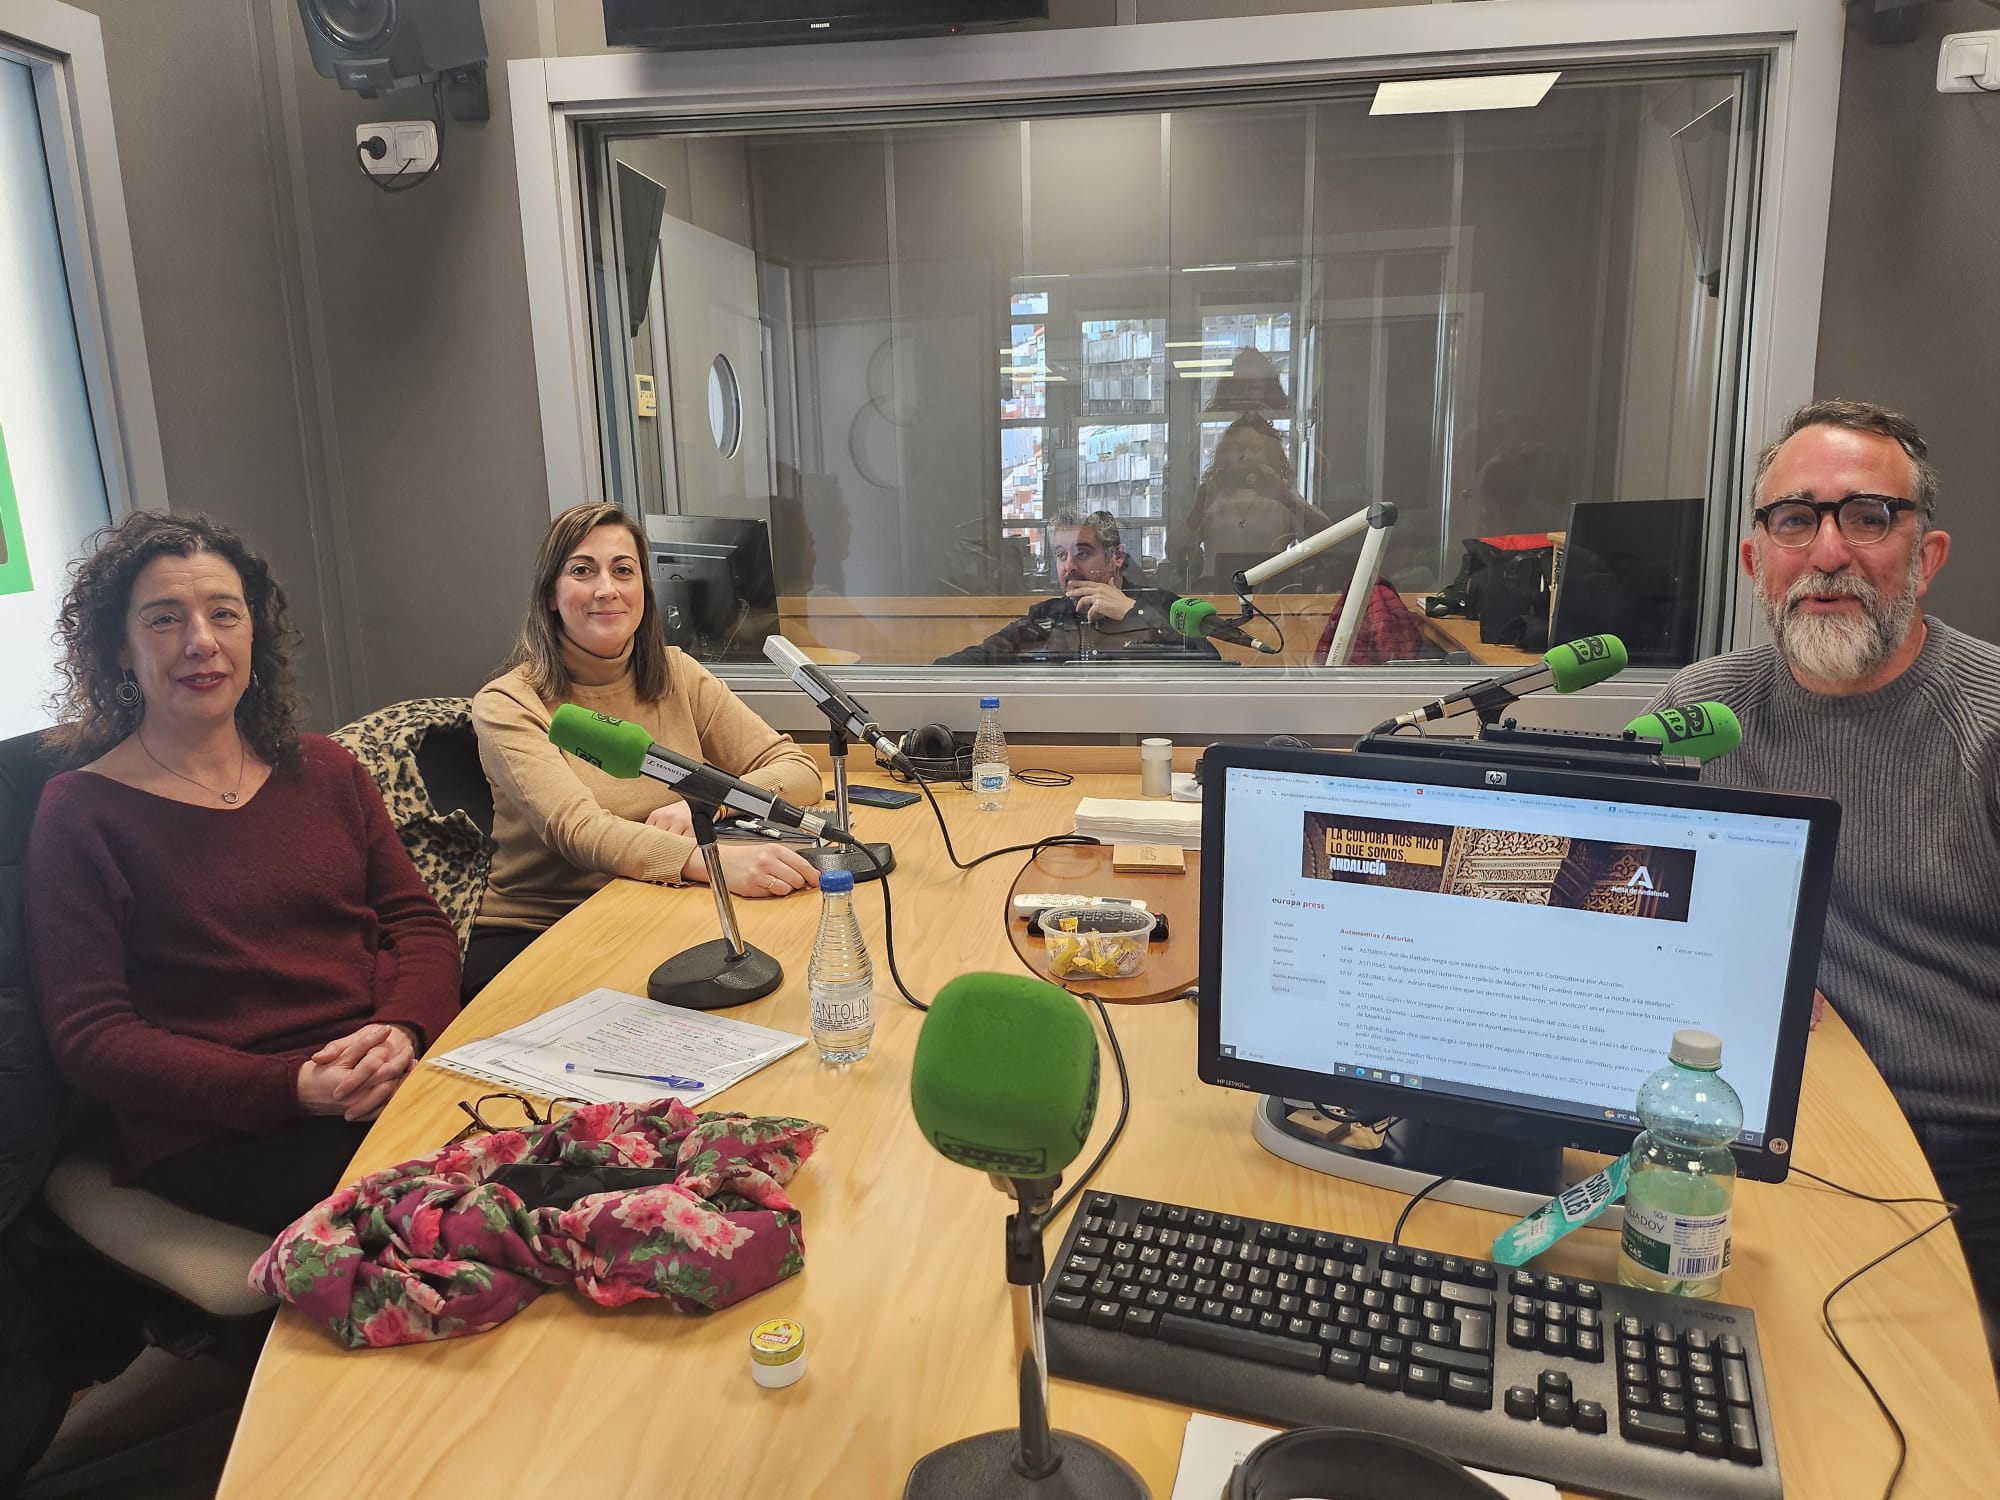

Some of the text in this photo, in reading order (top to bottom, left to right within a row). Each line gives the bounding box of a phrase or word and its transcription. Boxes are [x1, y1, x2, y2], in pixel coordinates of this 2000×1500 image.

[656, 762, 689, 778] SENNHEISE
[1330, 827, 1438, 851] LA CULTURA NOS HIZO
[1330, 841, 1342, 854] LO
[1345, 843, 1364, 857] QUE
[1329, 854, 1387, 876] ANDALUCÍA
[1272, 896, 1325, 911] europa press
[1339, 927, 1380, 939] Autonomías
[1385, 933, 1414, 943] Asturias
[1628, 1205, 1665, 1233] UADOY
